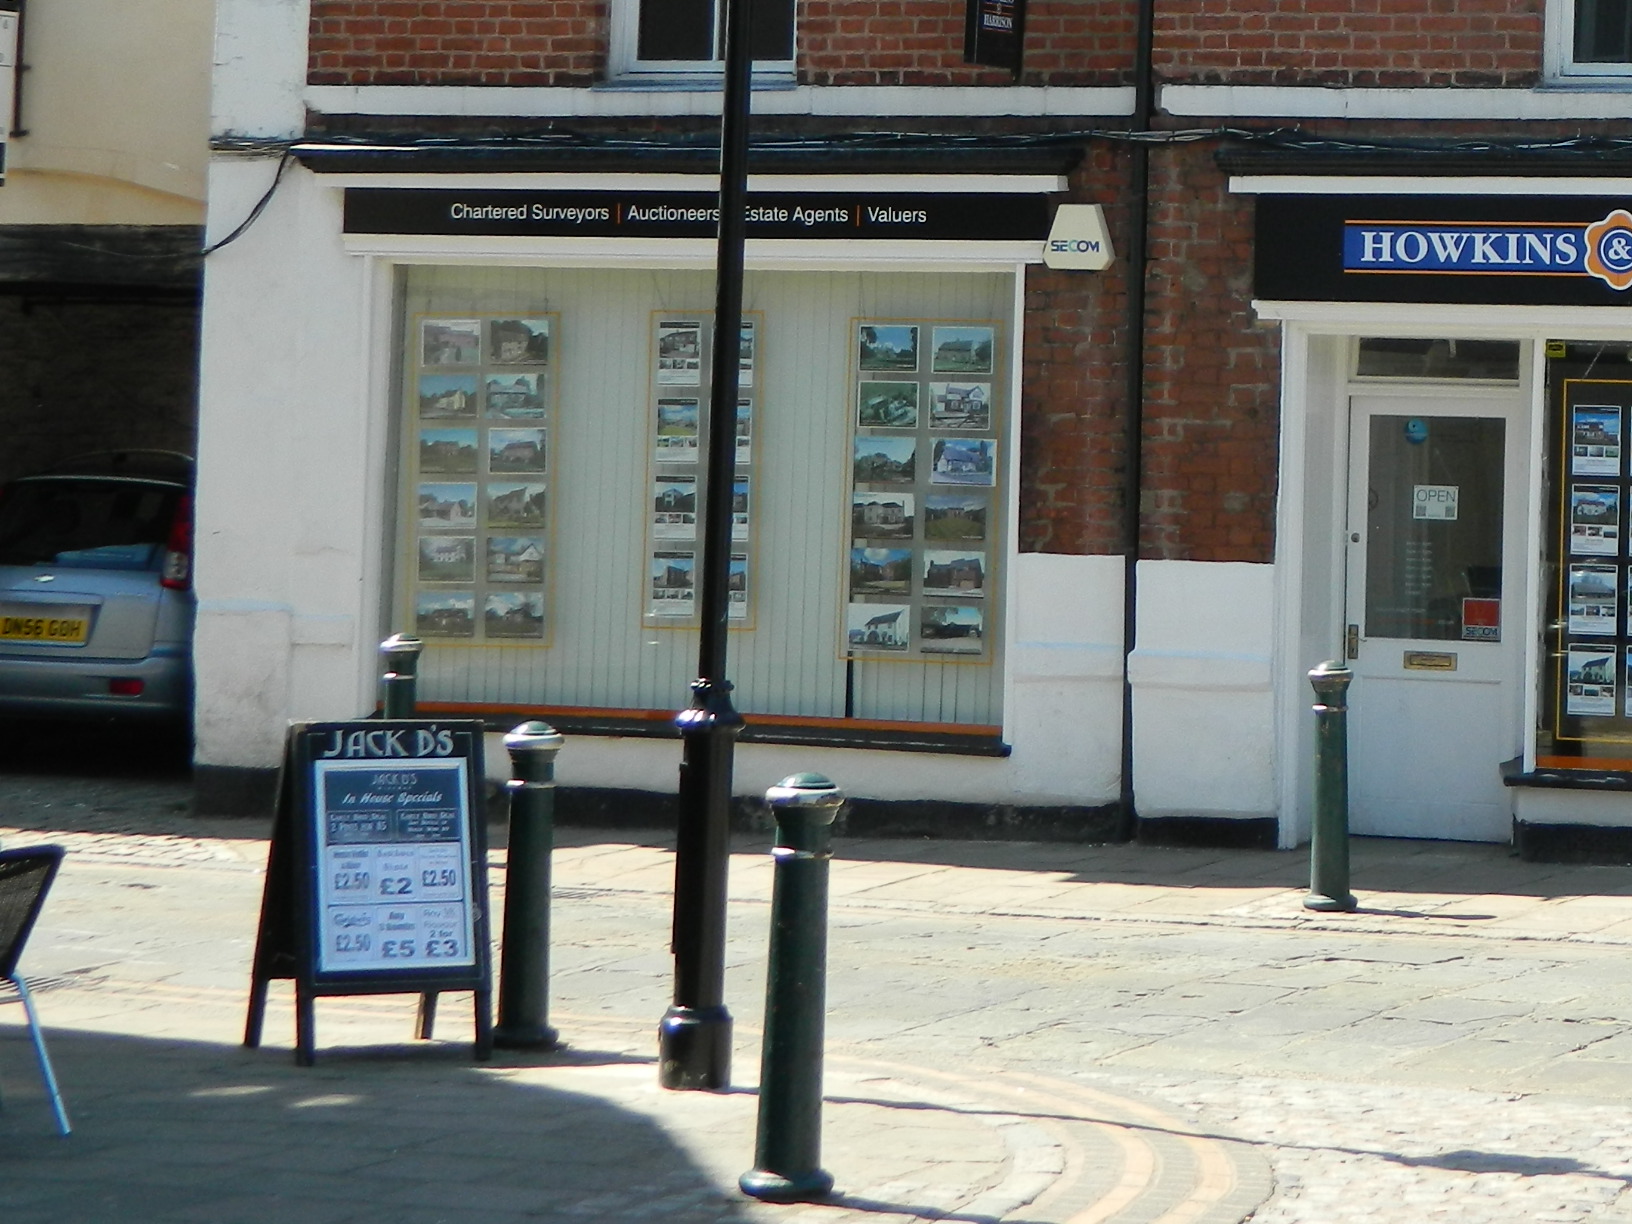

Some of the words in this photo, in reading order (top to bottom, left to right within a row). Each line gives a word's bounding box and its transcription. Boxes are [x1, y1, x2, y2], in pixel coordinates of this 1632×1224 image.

[450, 202, 528, 221] Chartered
[531, 203, 610, 225] Surveyors
[627, 204, 720, 223] Auctioneers
[793, 207, 849, 227] Agents
[867, 207, 927, 225] Valuers
[1051, 240, 1099, 253] SECOM
[1360, 231, 1578, 265] HOWKINS
[1607, 236, 1632, 261] &
[1416, 489, 1456, 503] OPEN
[324, 729, 409, 758] JACK
[416, 724, 455, 757] D'S
[341, 793, 356, 804] In
[397, 790, 443, 806] Specials
[334, 872, 370, 890] £2.50
[379, 877, 413, 895] £2
[422, 869, 457, 887] £2.50
[381, 940, 415, 958] £5
[425, 939, 459, 957] £3
